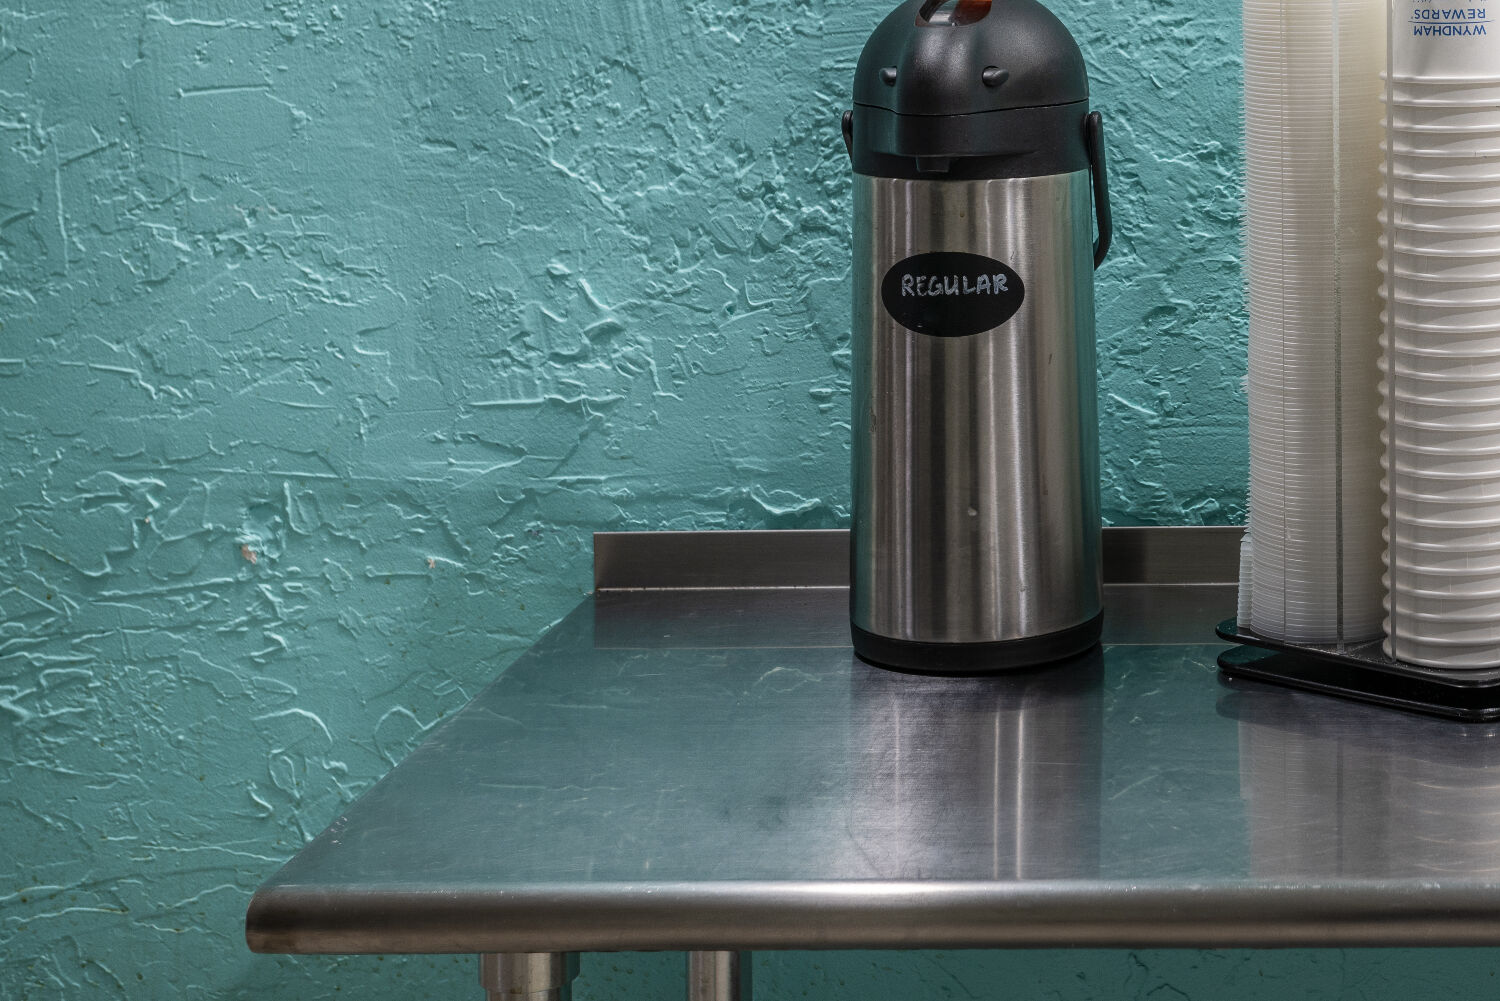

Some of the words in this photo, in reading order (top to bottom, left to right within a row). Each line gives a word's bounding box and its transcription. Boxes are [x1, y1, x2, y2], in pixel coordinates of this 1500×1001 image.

[1414, 8, 1486, 20] REWARDS
[1413, 25, 1487, 37] WYNDHAM
[901, 273, 1009, 297] REGULAR
